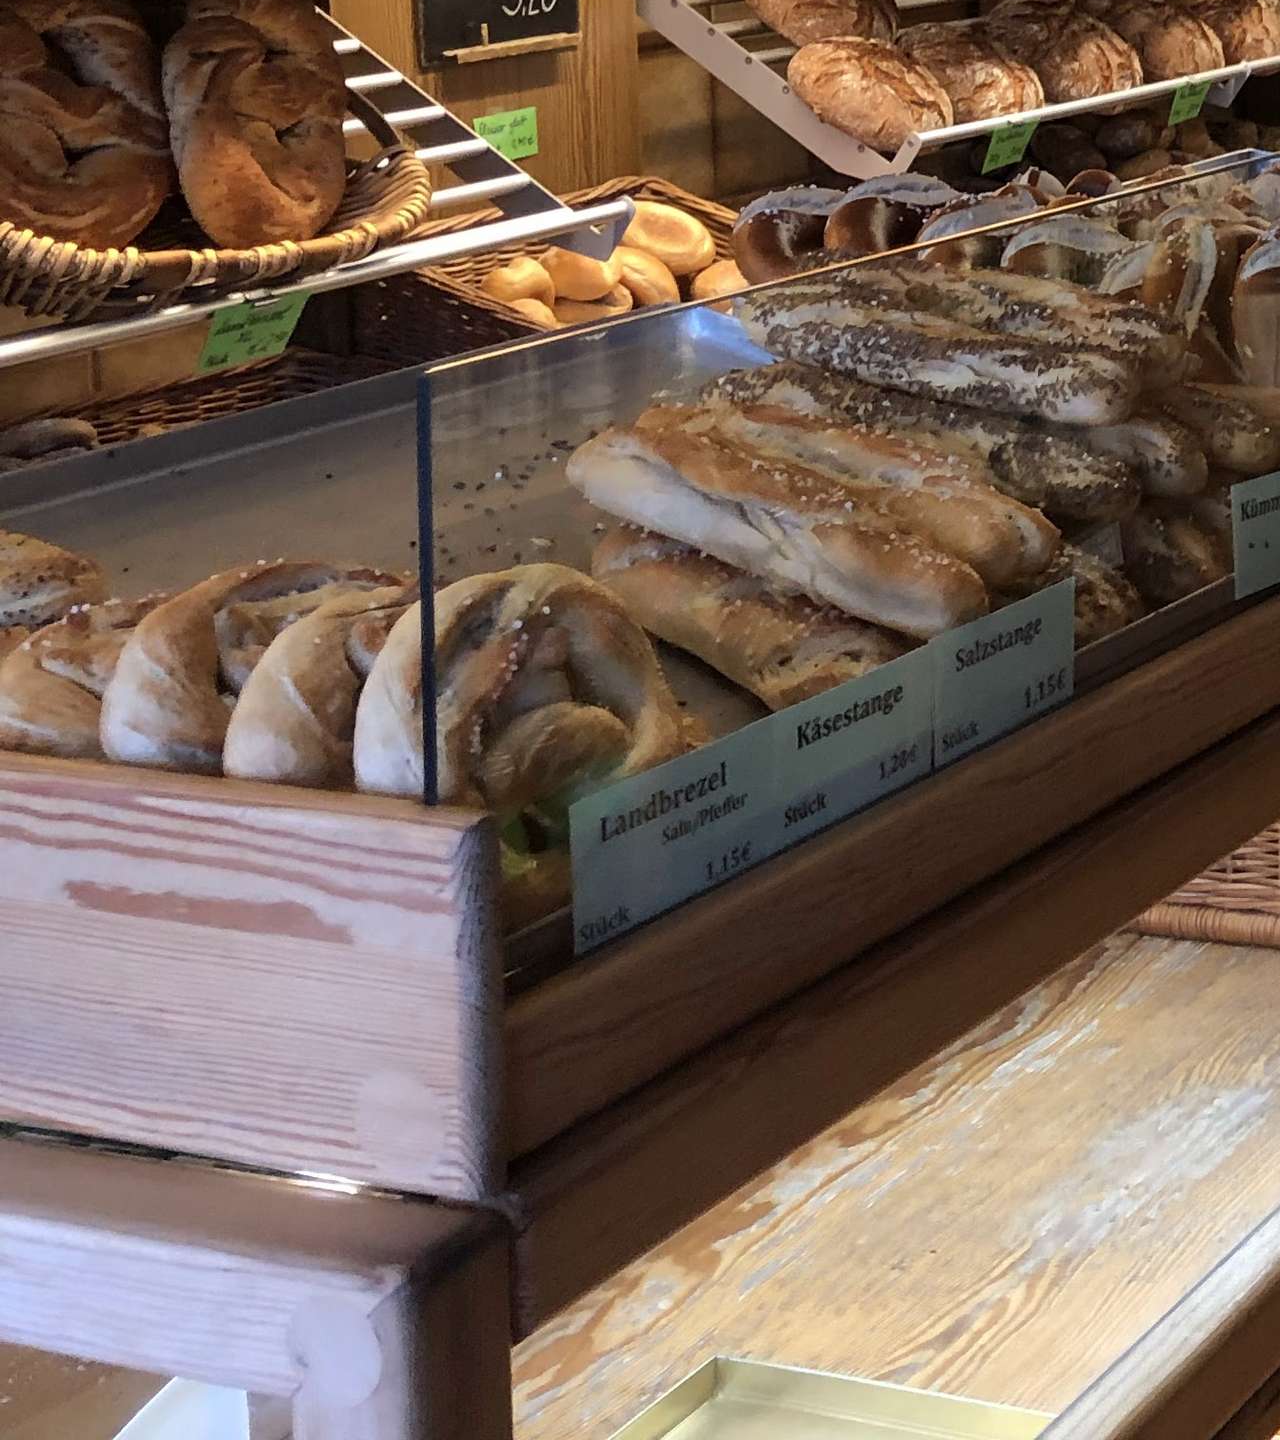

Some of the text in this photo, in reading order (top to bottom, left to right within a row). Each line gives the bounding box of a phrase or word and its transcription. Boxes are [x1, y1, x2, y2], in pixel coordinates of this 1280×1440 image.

[955, 616, 1043, 673] Salzstange
[796, 684, 904, 750] Käsestange
[600, 761, 729, 843] Landbrezel
